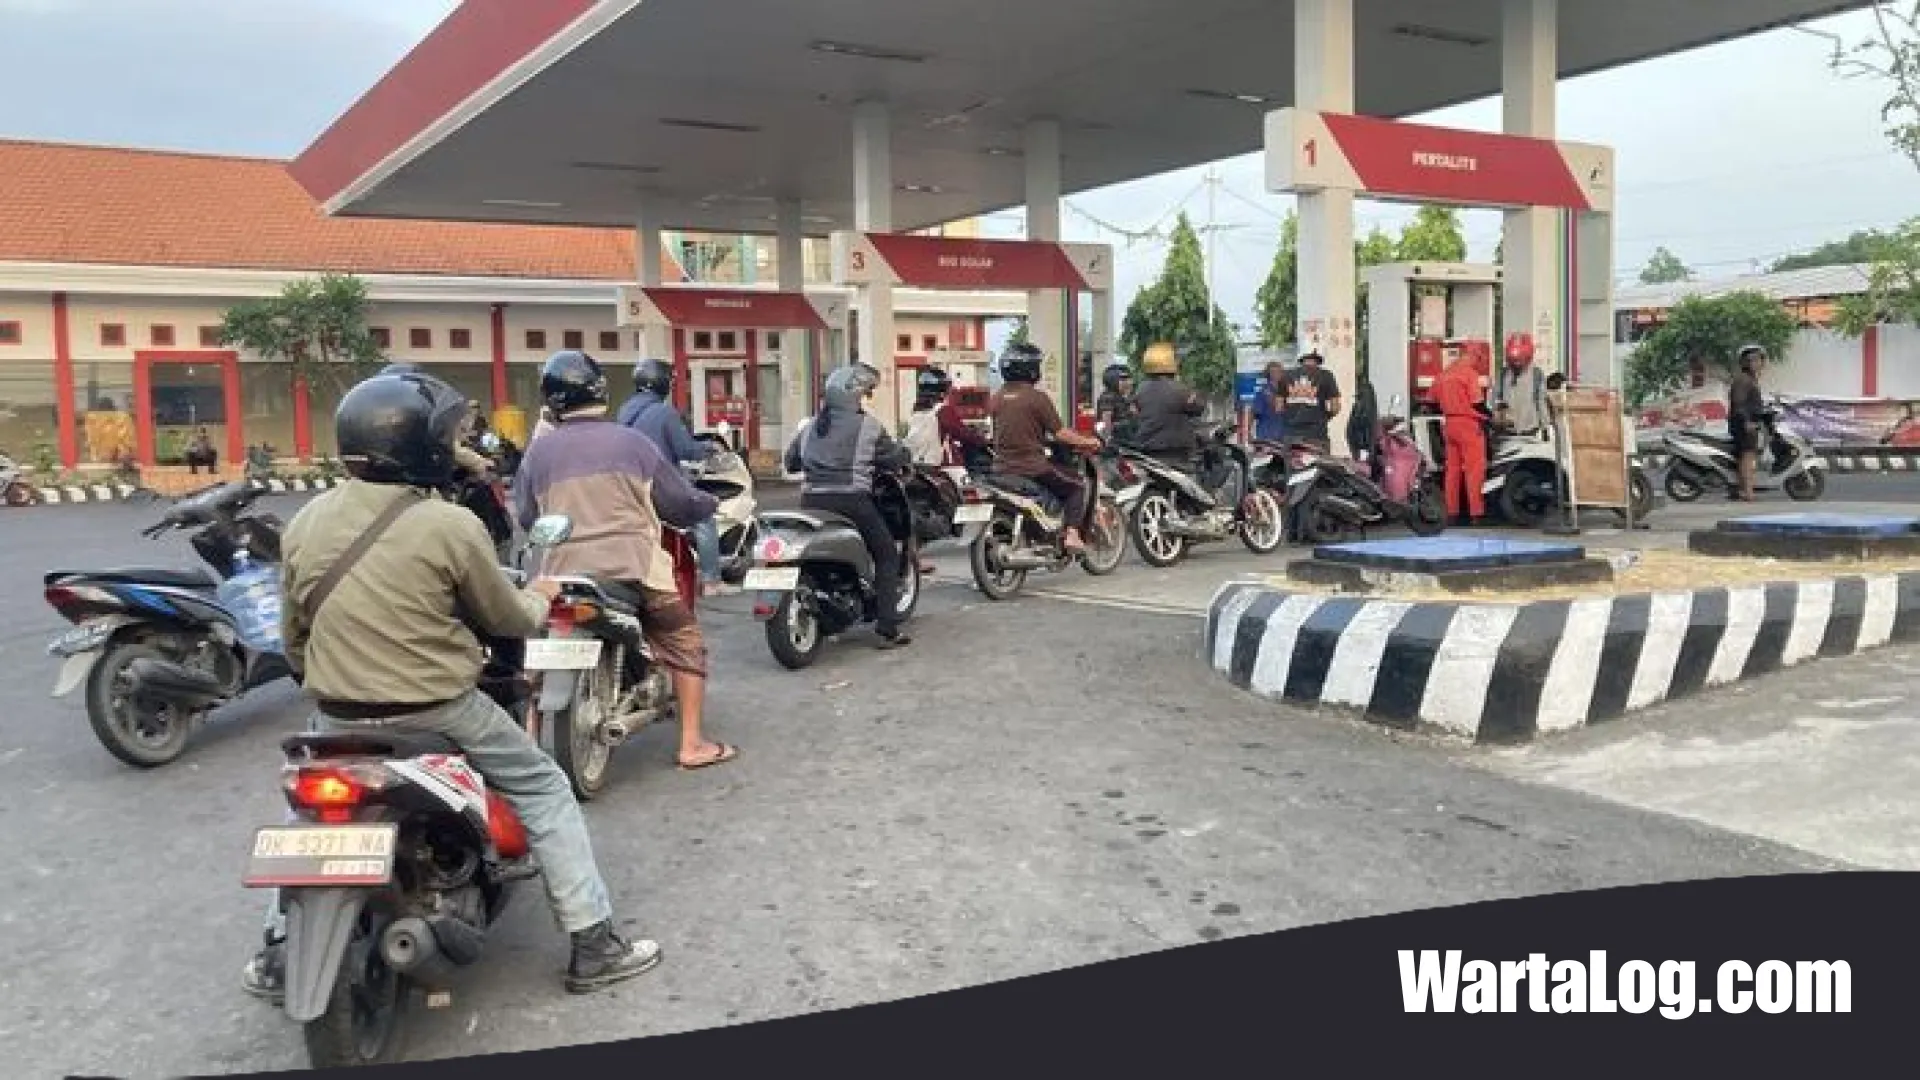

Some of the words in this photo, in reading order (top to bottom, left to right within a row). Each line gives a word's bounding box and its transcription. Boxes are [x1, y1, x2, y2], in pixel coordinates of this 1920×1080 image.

[1303, 139, 1316, 166] 1
[1412, 151, 1477, 171] PERTALITE
[851, 251, 865, 270] 3
[629, 300, 640, 316] 5
